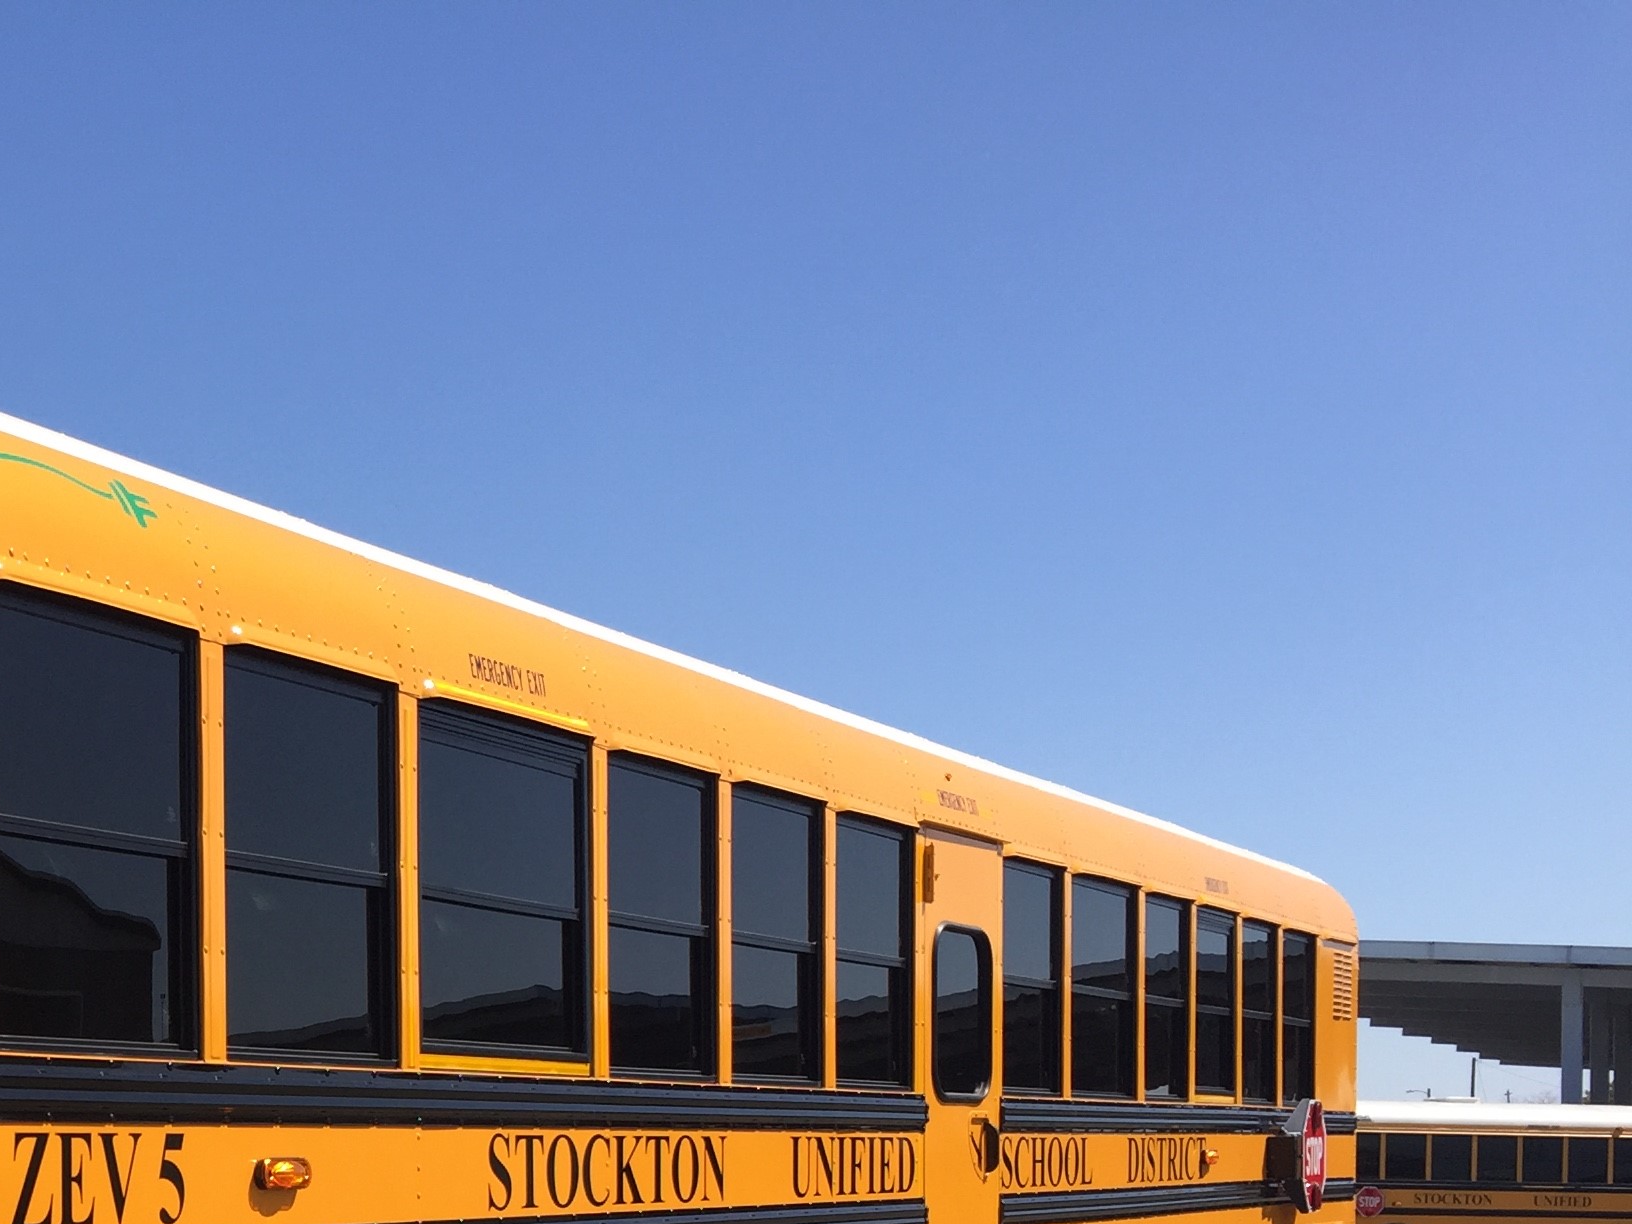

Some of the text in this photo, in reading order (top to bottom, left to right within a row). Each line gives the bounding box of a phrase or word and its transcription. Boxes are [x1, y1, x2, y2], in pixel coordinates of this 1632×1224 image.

[468, 653, 546, 697] EMERGENCY EXIT
[487, 1132, 1207, 1212] STOCKTON UNIFIED SCHOOL DISTRICT
[1306, 1136, 1323, 1176] STOP
[1358, 1195, 1381, 1208] STOP
[1414, 1193, 1593, 1208] STOCKTON UNIFIED
